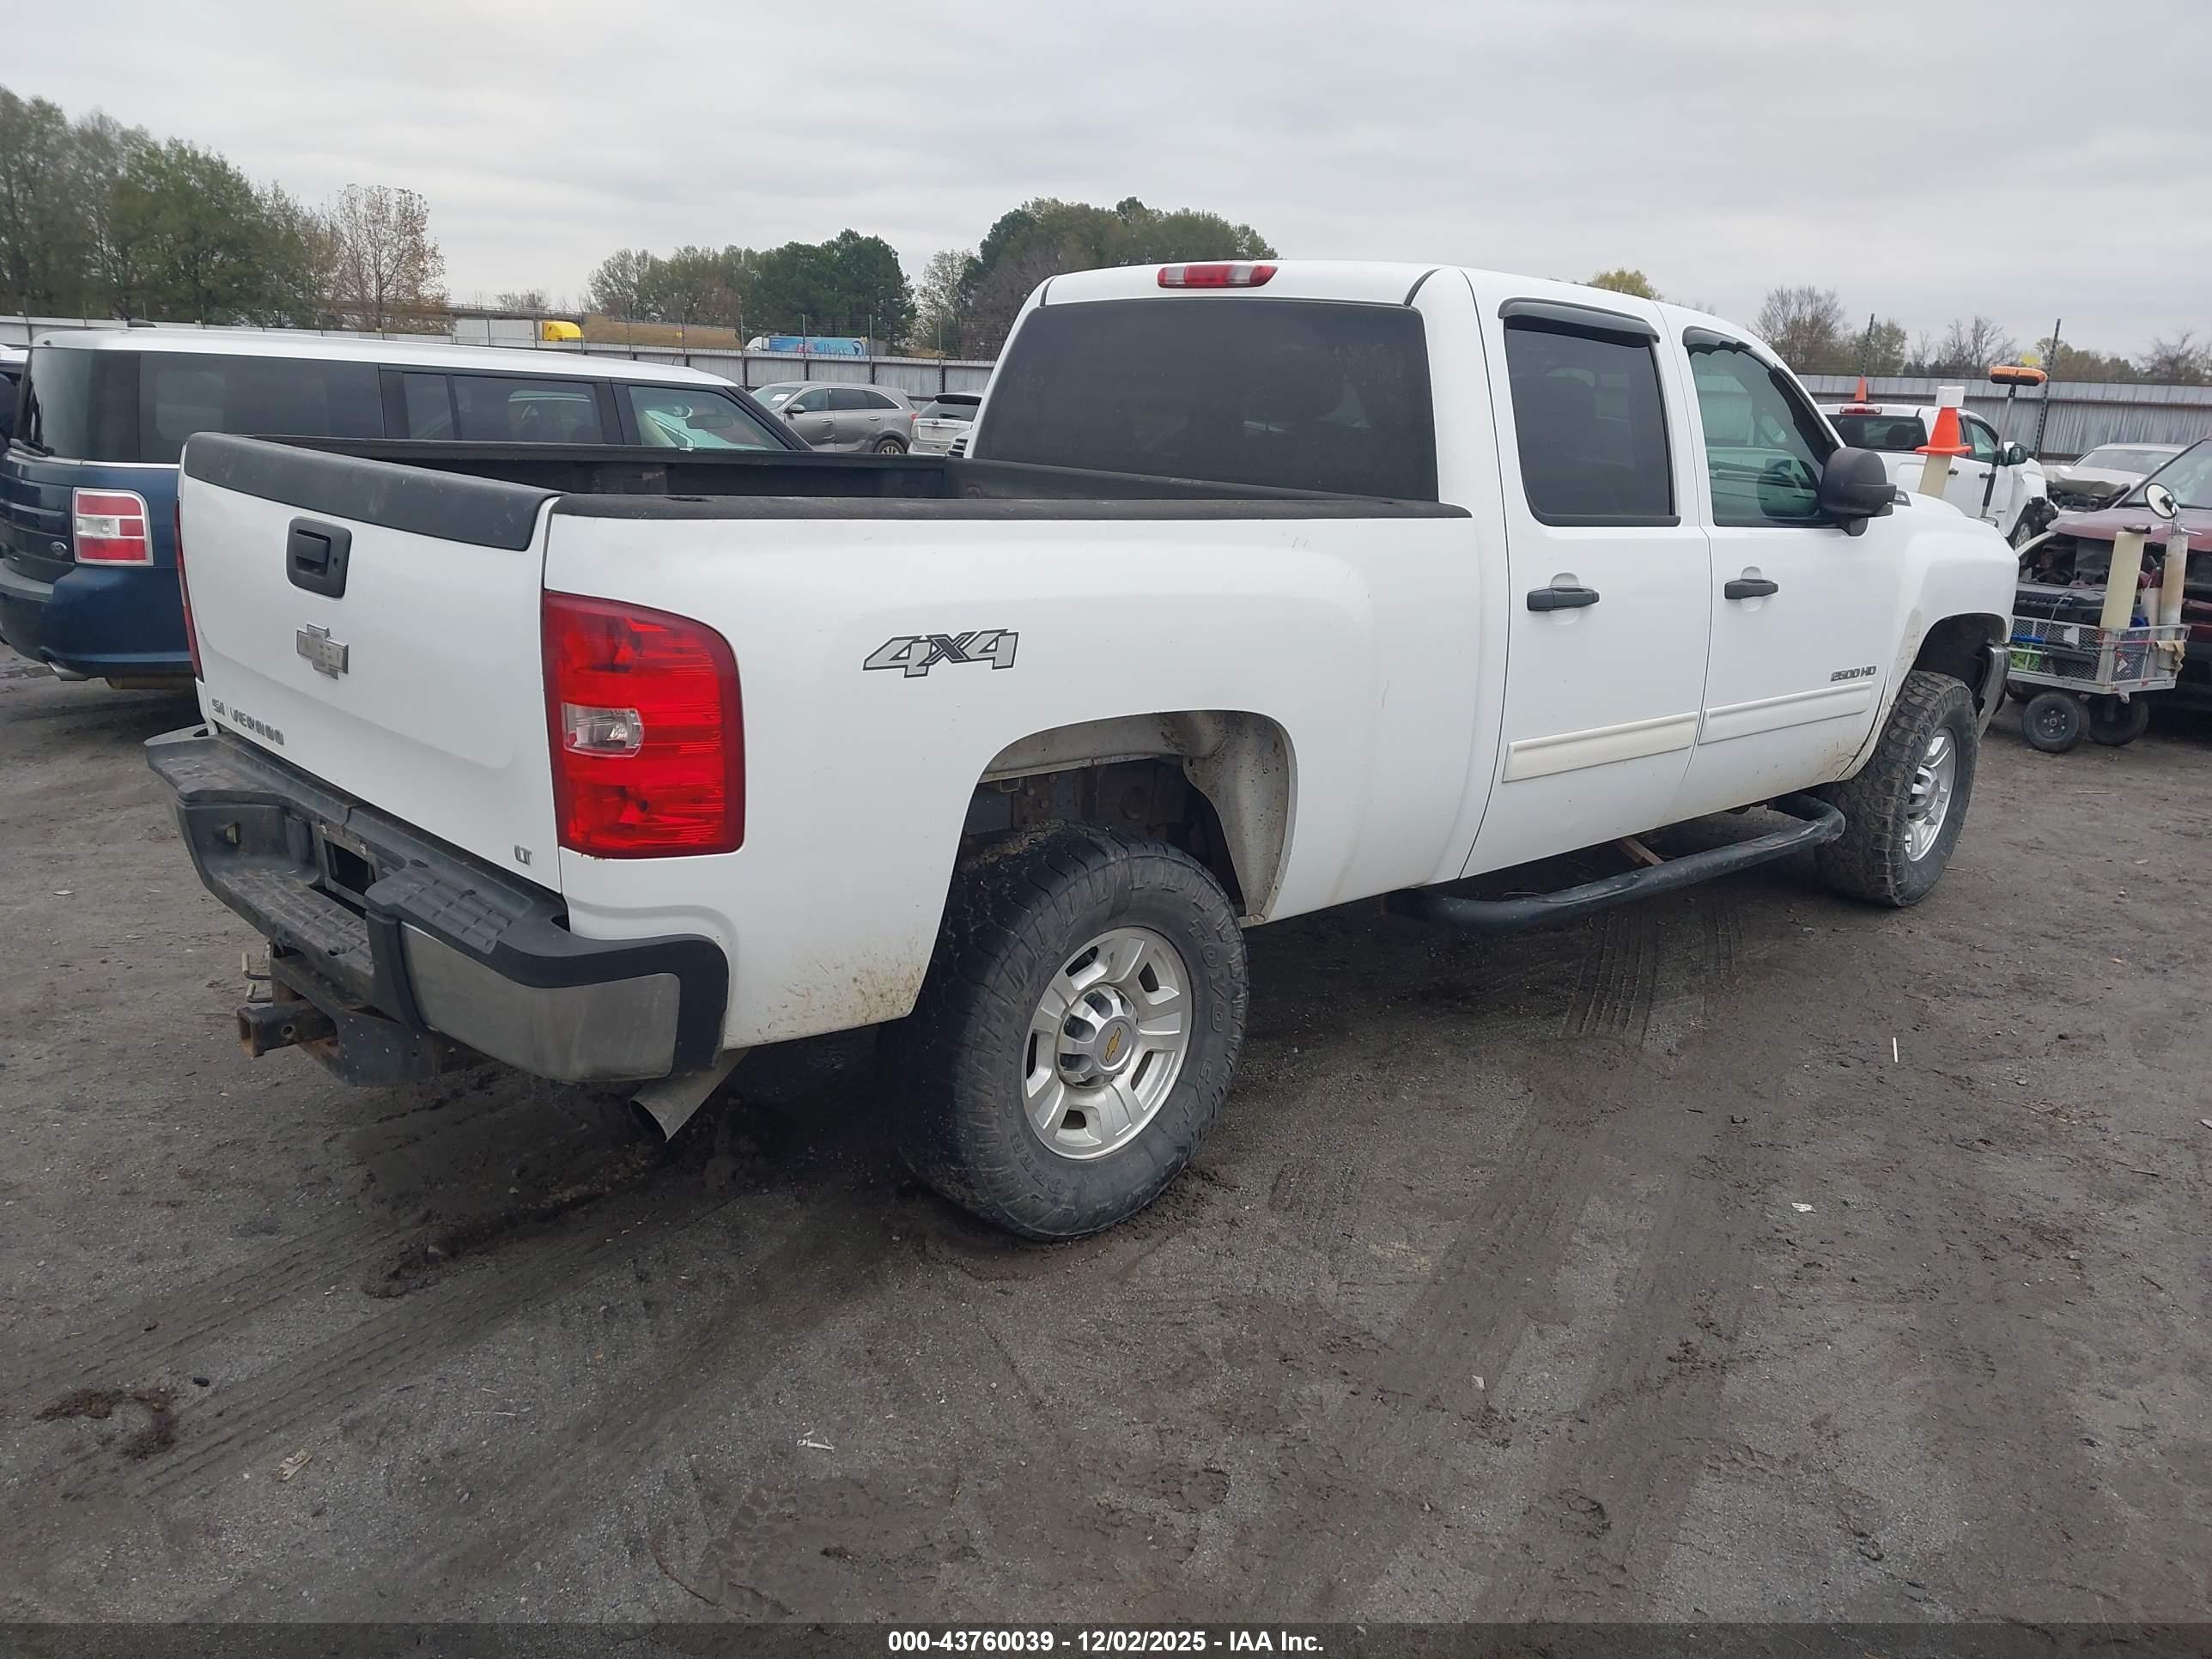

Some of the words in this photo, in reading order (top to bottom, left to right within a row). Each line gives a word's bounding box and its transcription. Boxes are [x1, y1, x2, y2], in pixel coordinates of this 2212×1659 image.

[1830, 669, 1860, 682] 2500
[1861, 665, 1876, 677] HD
[514, 845, 532, 866] LT
[1188, 918, 1226, 1032] TOYO
